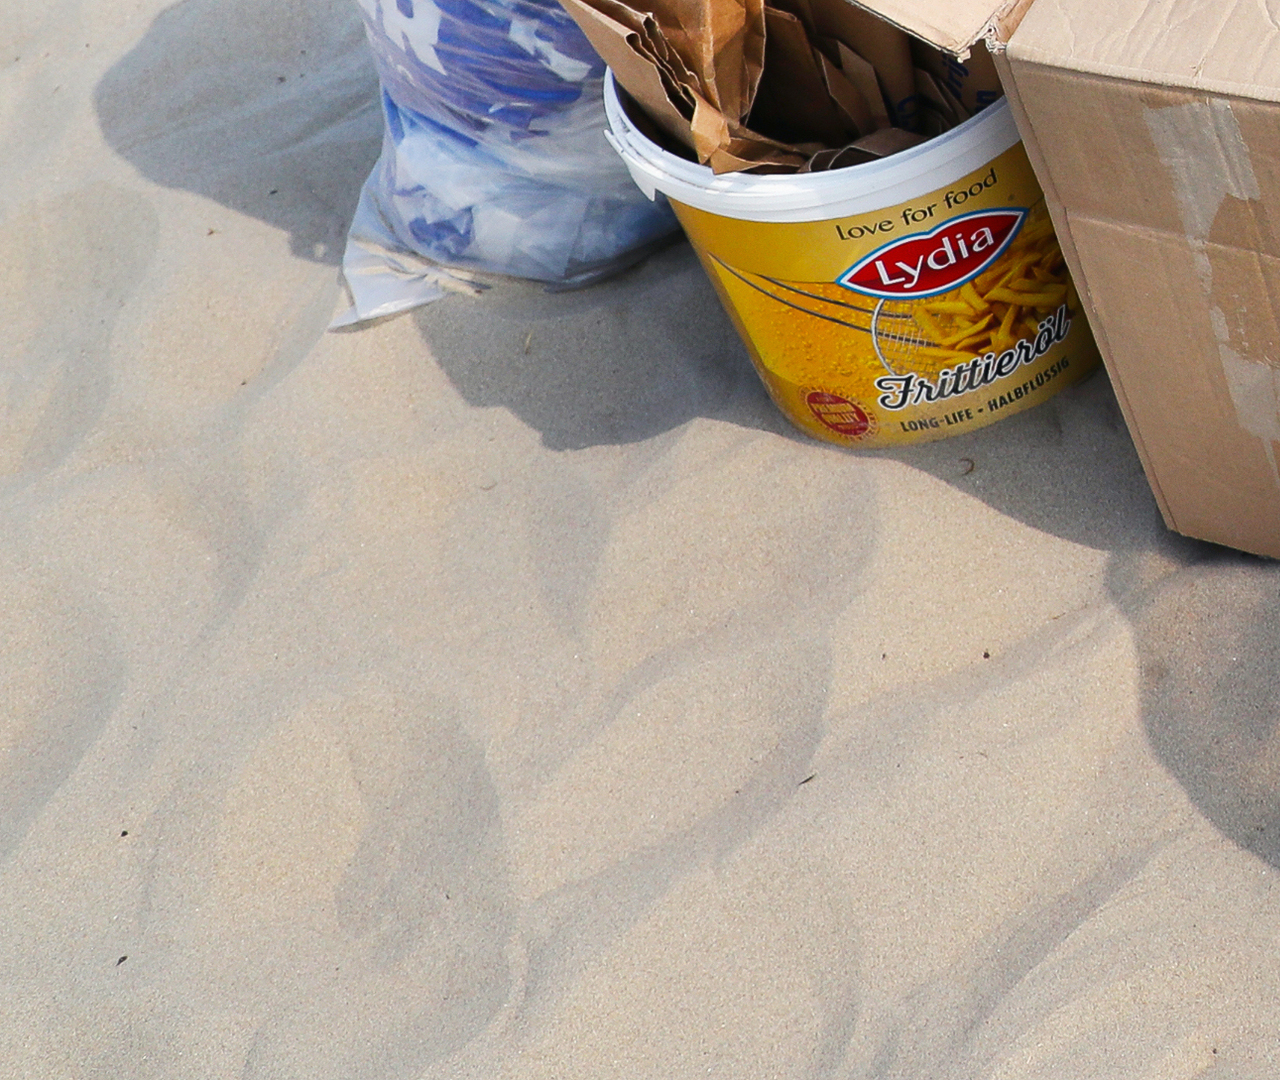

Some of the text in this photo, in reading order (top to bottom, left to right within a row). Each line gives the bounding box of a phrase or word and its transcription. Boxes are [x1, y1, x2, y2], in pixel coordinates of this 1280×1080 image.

[835, 167, 998, 241] Love for food
[874, 226, 995, 289] Lydia
[875, 304, 1071, 411] Frittieröl
[900, 408, 973, 433] LONG-LIFE
